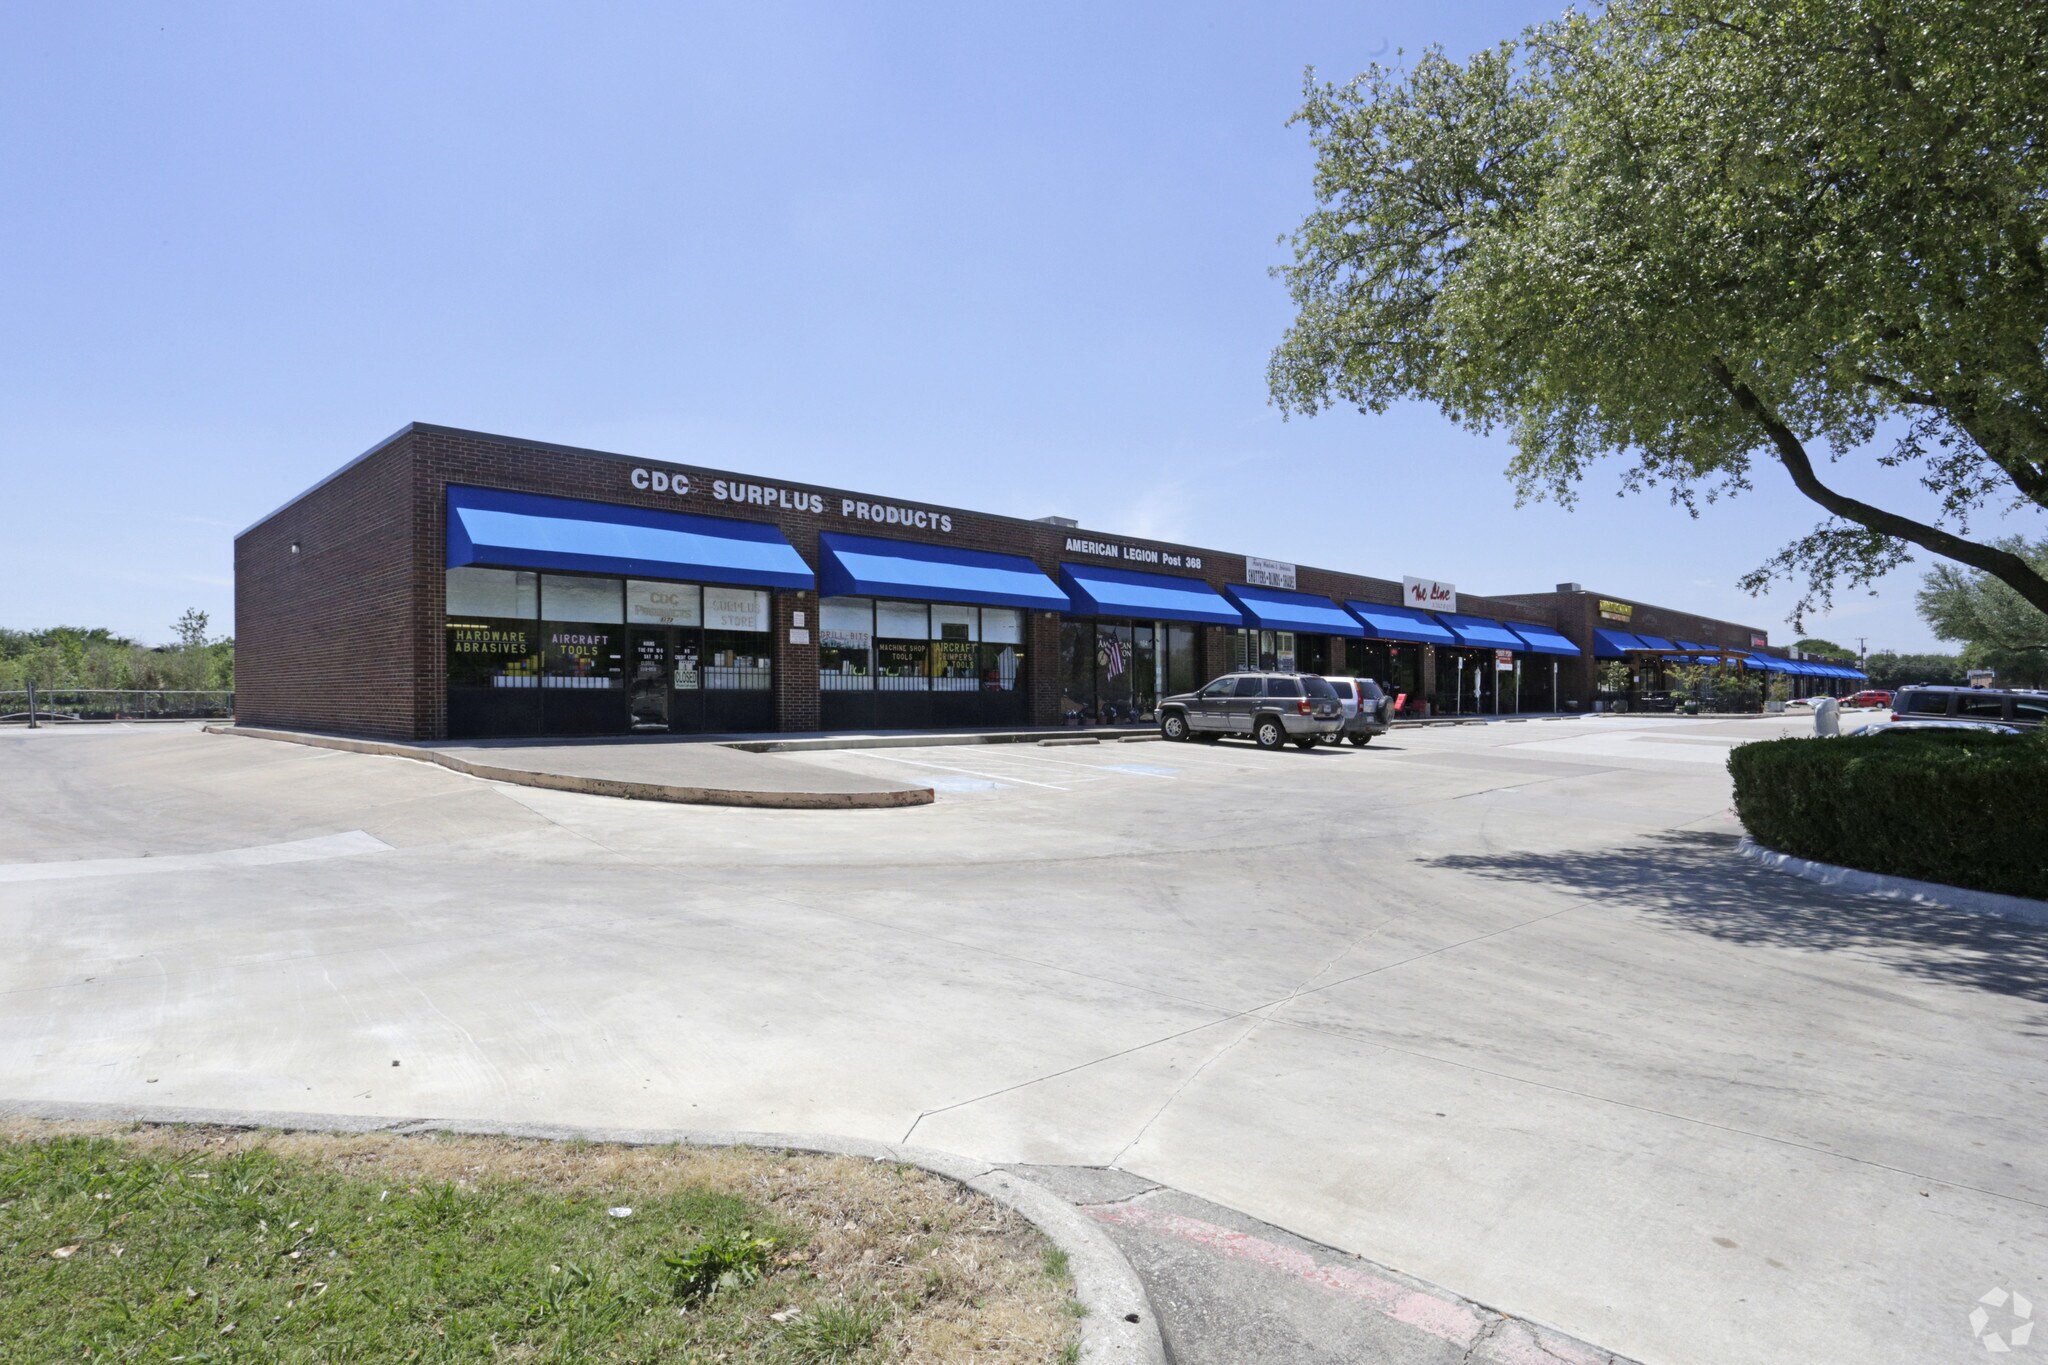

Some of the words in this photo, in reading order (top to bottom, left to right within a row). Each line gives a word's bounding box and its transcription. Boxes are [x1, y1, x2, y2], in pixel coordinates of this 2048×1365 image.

[631, 468, 689, 495] CDC
[713, 480, 824, 514] SURPLUS
[842, 499, 952, 532] PRODUCTS
[1066, 538, 1118, 557] AMERICAN
[1124, 547, 1158, 564] LEGION
[1162, 553, 1181, 567] Post
[1185, 557, 1202, 569] 368
[1412, 583, 1427, 601] The
[1430, 582, 1450, 601] Line
[650, 592, 679, 605] CDC
[713, 600, 761, 614] SURPLUS
[721, 616, 755, 628] STORE
[456, 630, 525, 642] HARDWARE
[552, 634, 608, 645] AIRCRAFT
[455, 643, 527, 653] ABRASIVES
[561, 645, 598, 655] TOOLS
[879, 644, 907, 652] MACHINE
[936, 642, 977, 653] AIRCRAFT
[892, 653, 913, 661] TOOLS
[952, 661, 974, 669] TOOLS
[676, 671, 697, 683] CLOSED
